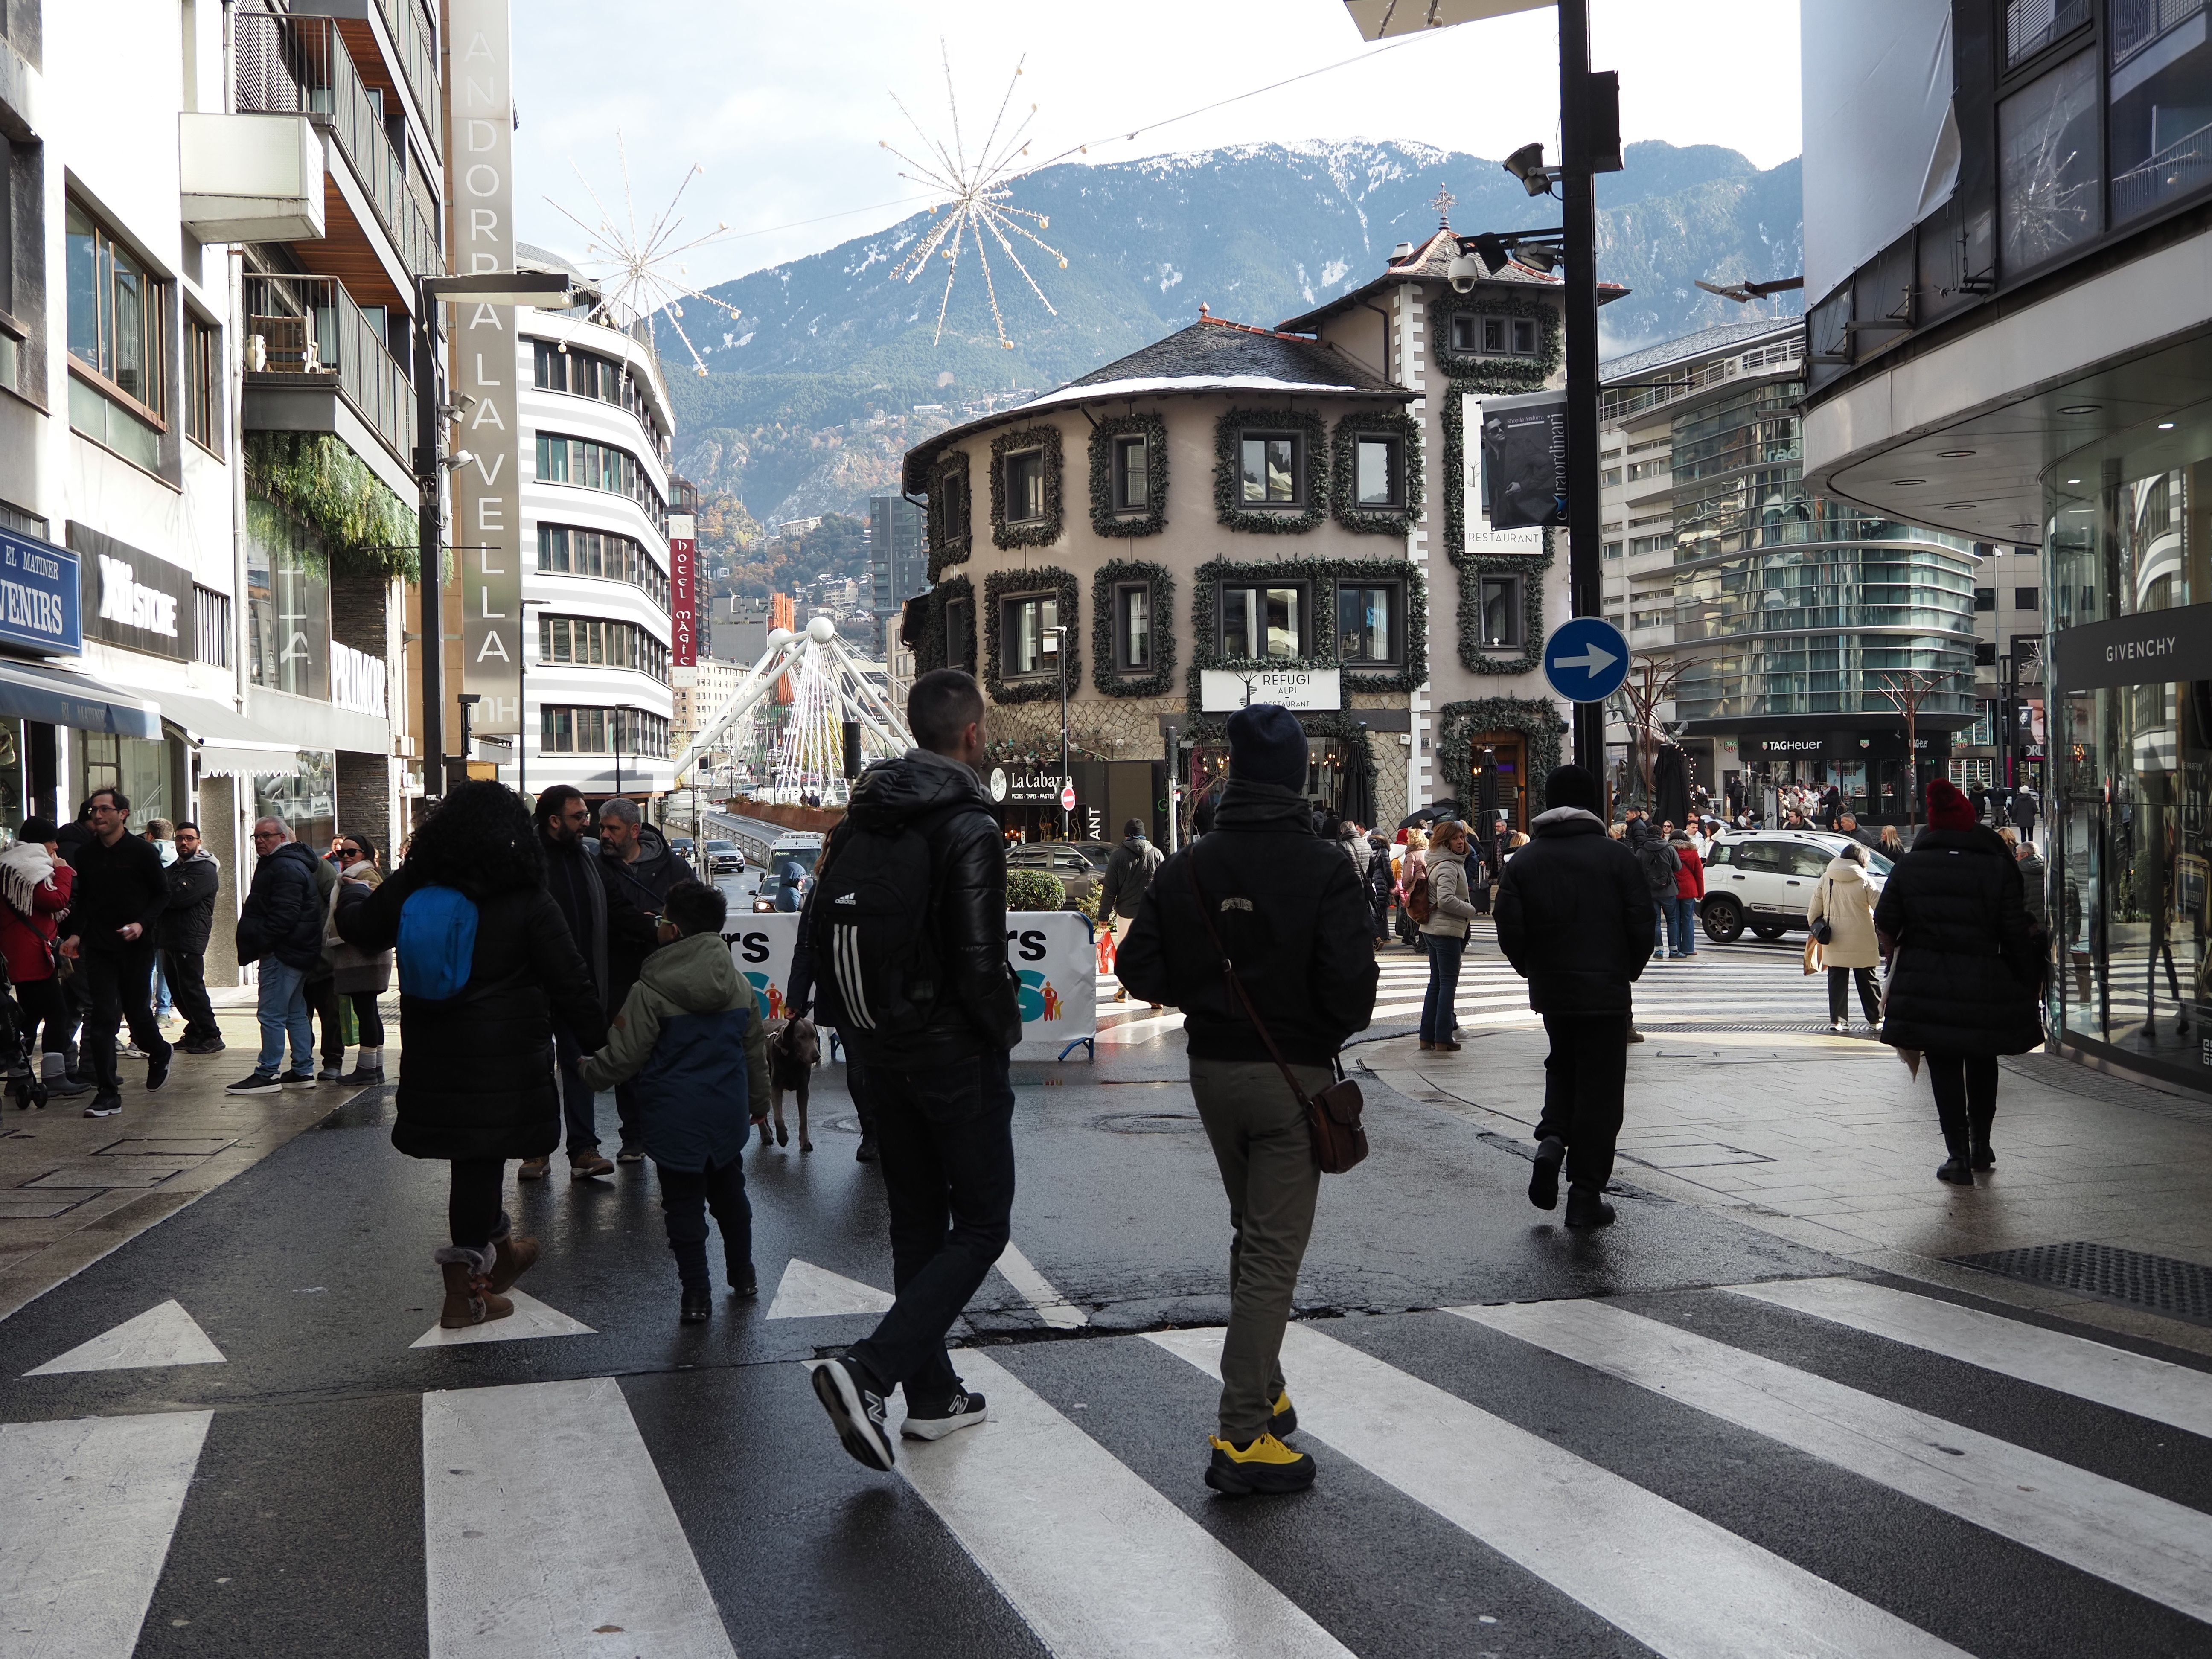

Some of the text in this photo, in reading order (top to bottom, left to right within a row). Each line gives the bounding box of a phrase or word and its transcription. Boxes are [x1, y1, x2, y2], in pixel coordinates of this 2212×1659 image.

[1469, 532, 1539, 543] RESTAURANT
[6, 545, 59, 581] EL MATINER
[473, 453, 510, 662] VELLA
[2106, 636, 2176, 662] GIVENCHY
[1263, 674, 1310, 685] REFUGI
[1011, 773, 1024, 788] La
